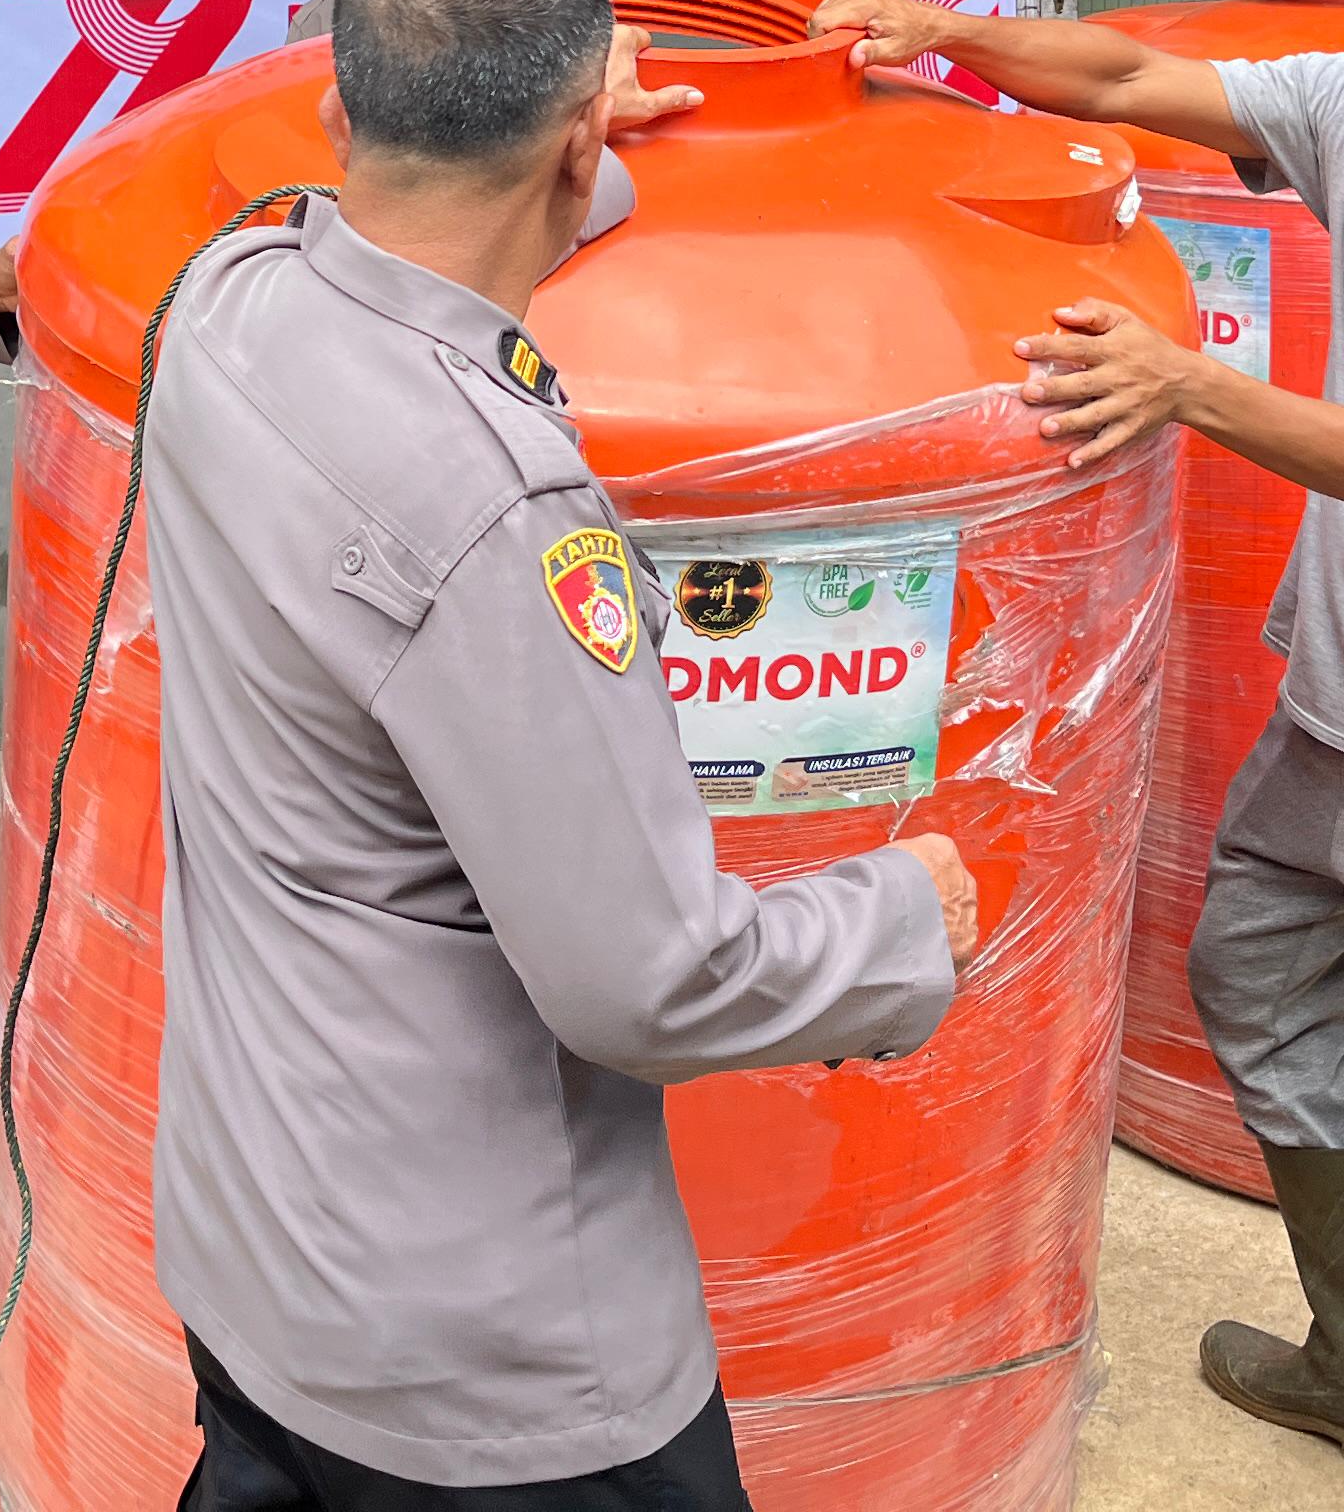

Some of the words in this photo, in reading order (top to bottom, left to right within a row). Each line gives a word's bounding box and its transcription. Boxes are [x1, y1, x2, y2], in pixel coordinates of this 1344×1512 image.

[549, 534, 616, 568] TAHTI
[821, 564, 849, 582] BPA
[818, 583, 849, 600] FREE
[659, 646, 909, 703] DMOND
[691, 765, 721, 776] HAN
[720, 764, 755, 776] LAMA
[808, 755, 865, 772] INSULASI
[865, 748, 912, 766] TERBAIK
